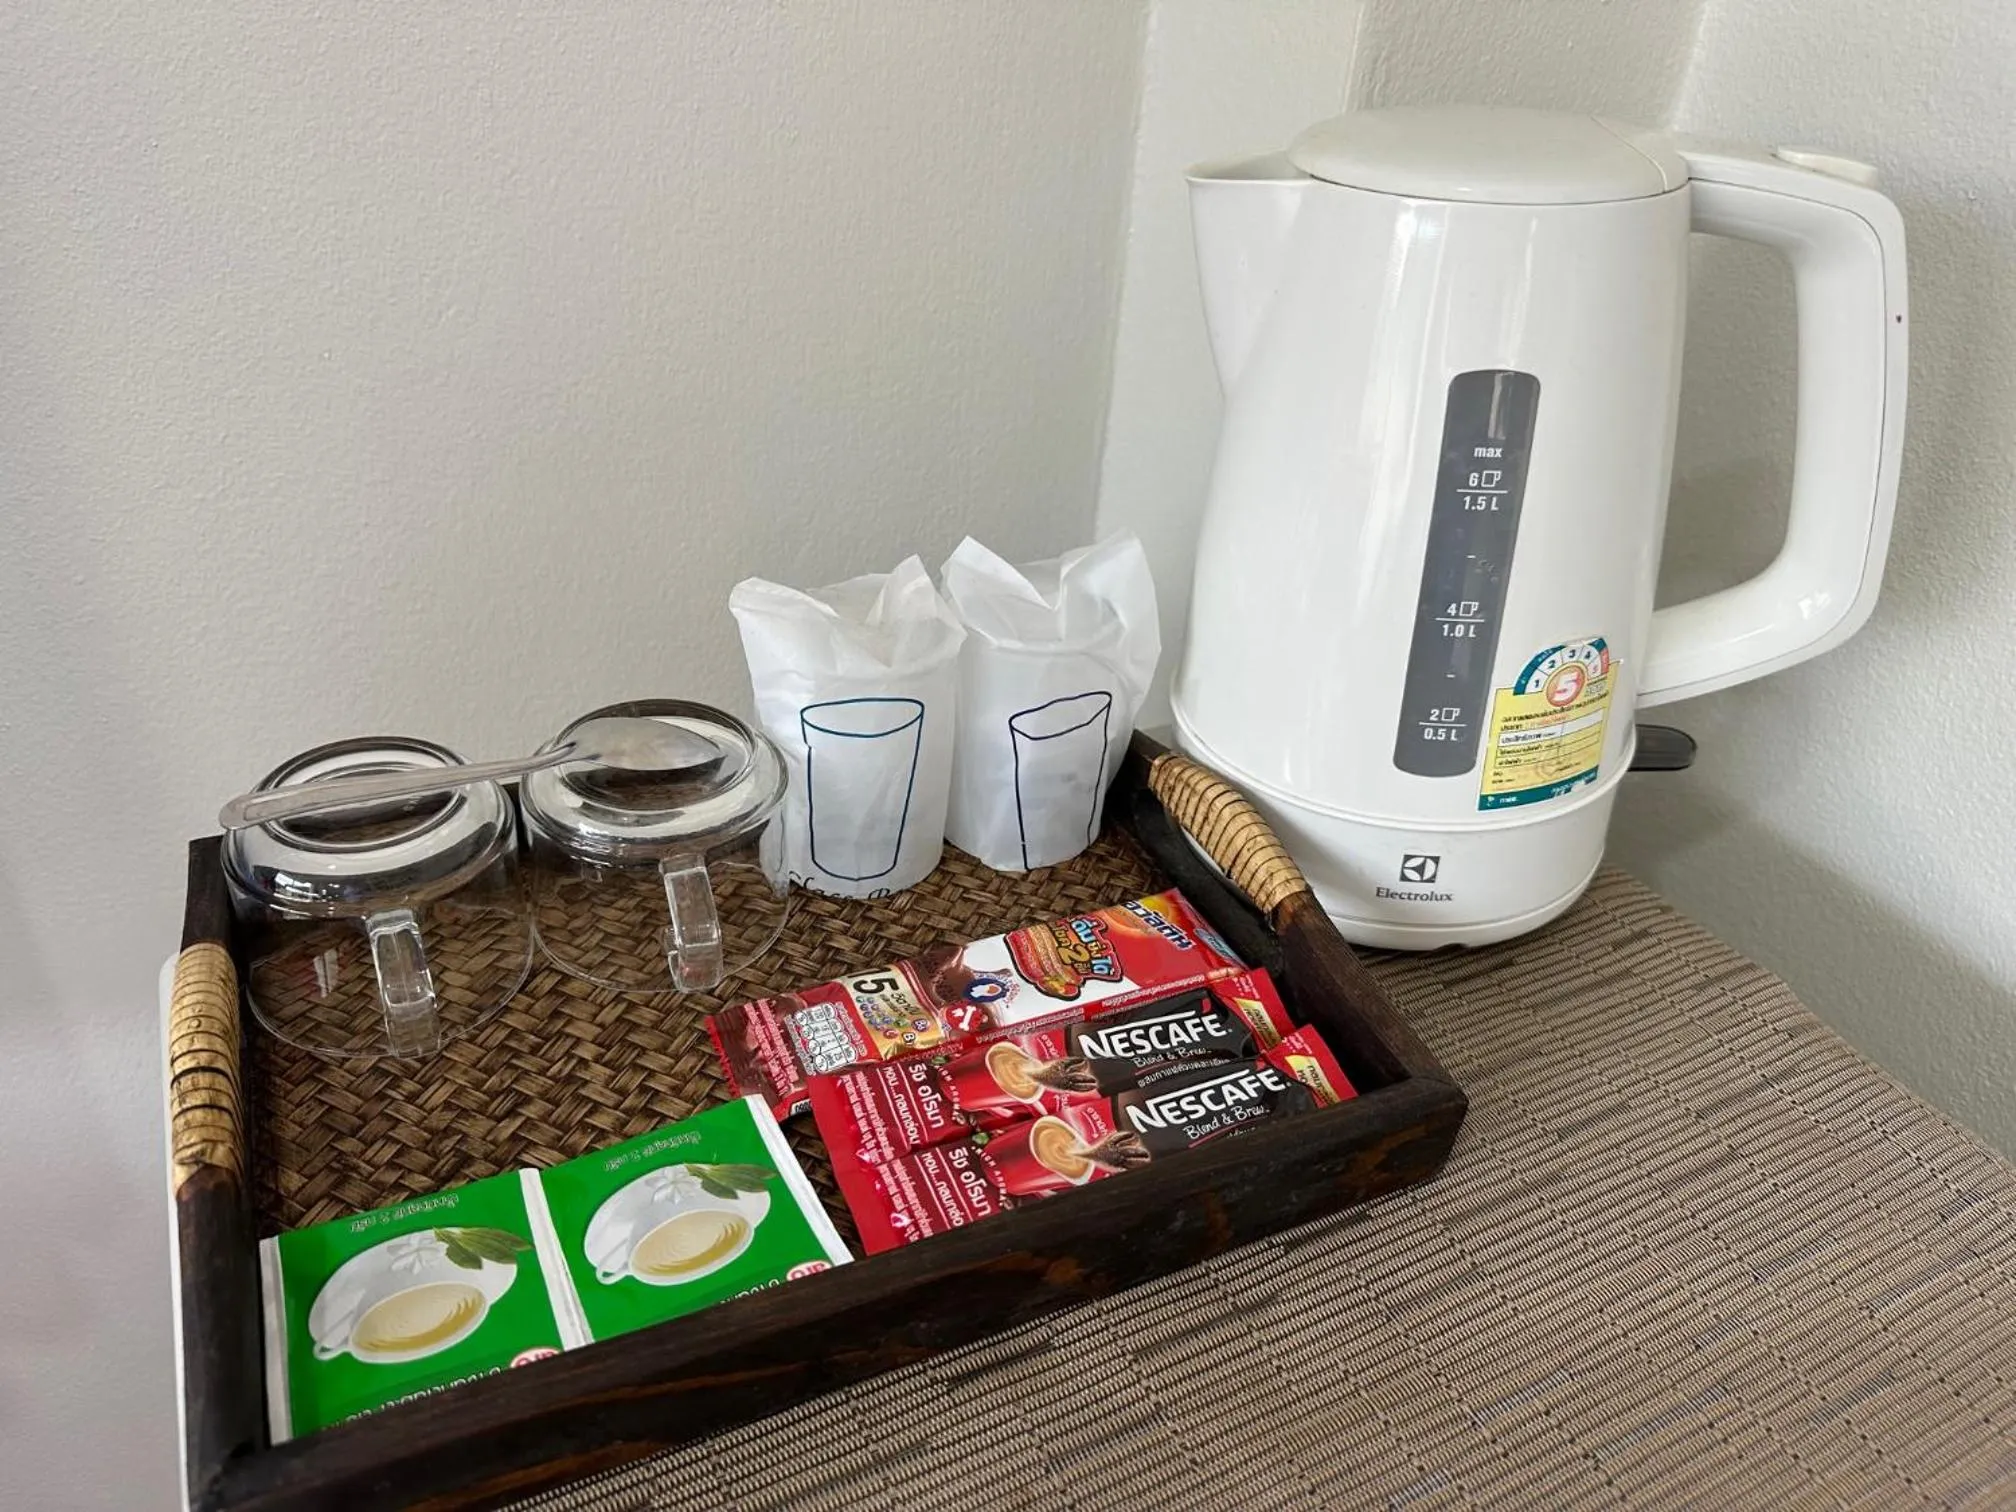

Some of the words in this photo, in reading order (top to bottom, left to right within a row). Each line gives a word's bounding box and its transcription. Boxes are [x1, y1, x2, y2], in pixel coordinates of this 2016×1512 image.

[1474, 447, 1502, 458] max
[1469, 472, 1478, 488] 6
[1463, 496, 1486, 511] 1.5
[1490, 497, 1499, 511] L
[1447, 603, 1457, 616] 4
[1442, 624, 1464, 638] 1.0
[1468, 626, 1477, 638] L
[1568, 649, 1577, 659] 3
[1548, 659, 1556, 668] 2
[1534, 680, 1541, 688] 1
[1554, 669, 1581, 701] 5
[1429, 709, 1439, 721] 2
[1424, 728, 1446, 740] 0.5
[1450, 729, 1458, 741] L
[1375, 886, 1453, 902] Electrolux
[1133, 1051, 1164, 1069] Blend
[1166, 1051, 1177, 1062] &
[909, 1063, 926, 1083] ริช
[917, 1086, 944, 1128] อโรมา
[1182, 1116, 1221, 1141] Blend
[1221, 1113, 1234, 1126] &
[1230, 1105, 1265, 1124] Brew
[949, 1148, 966, 1168] ริช
[961, 1171, 991, 1215] อโรมา
[922, 1152, 964, 1227] หอม...กลมกล่อ
